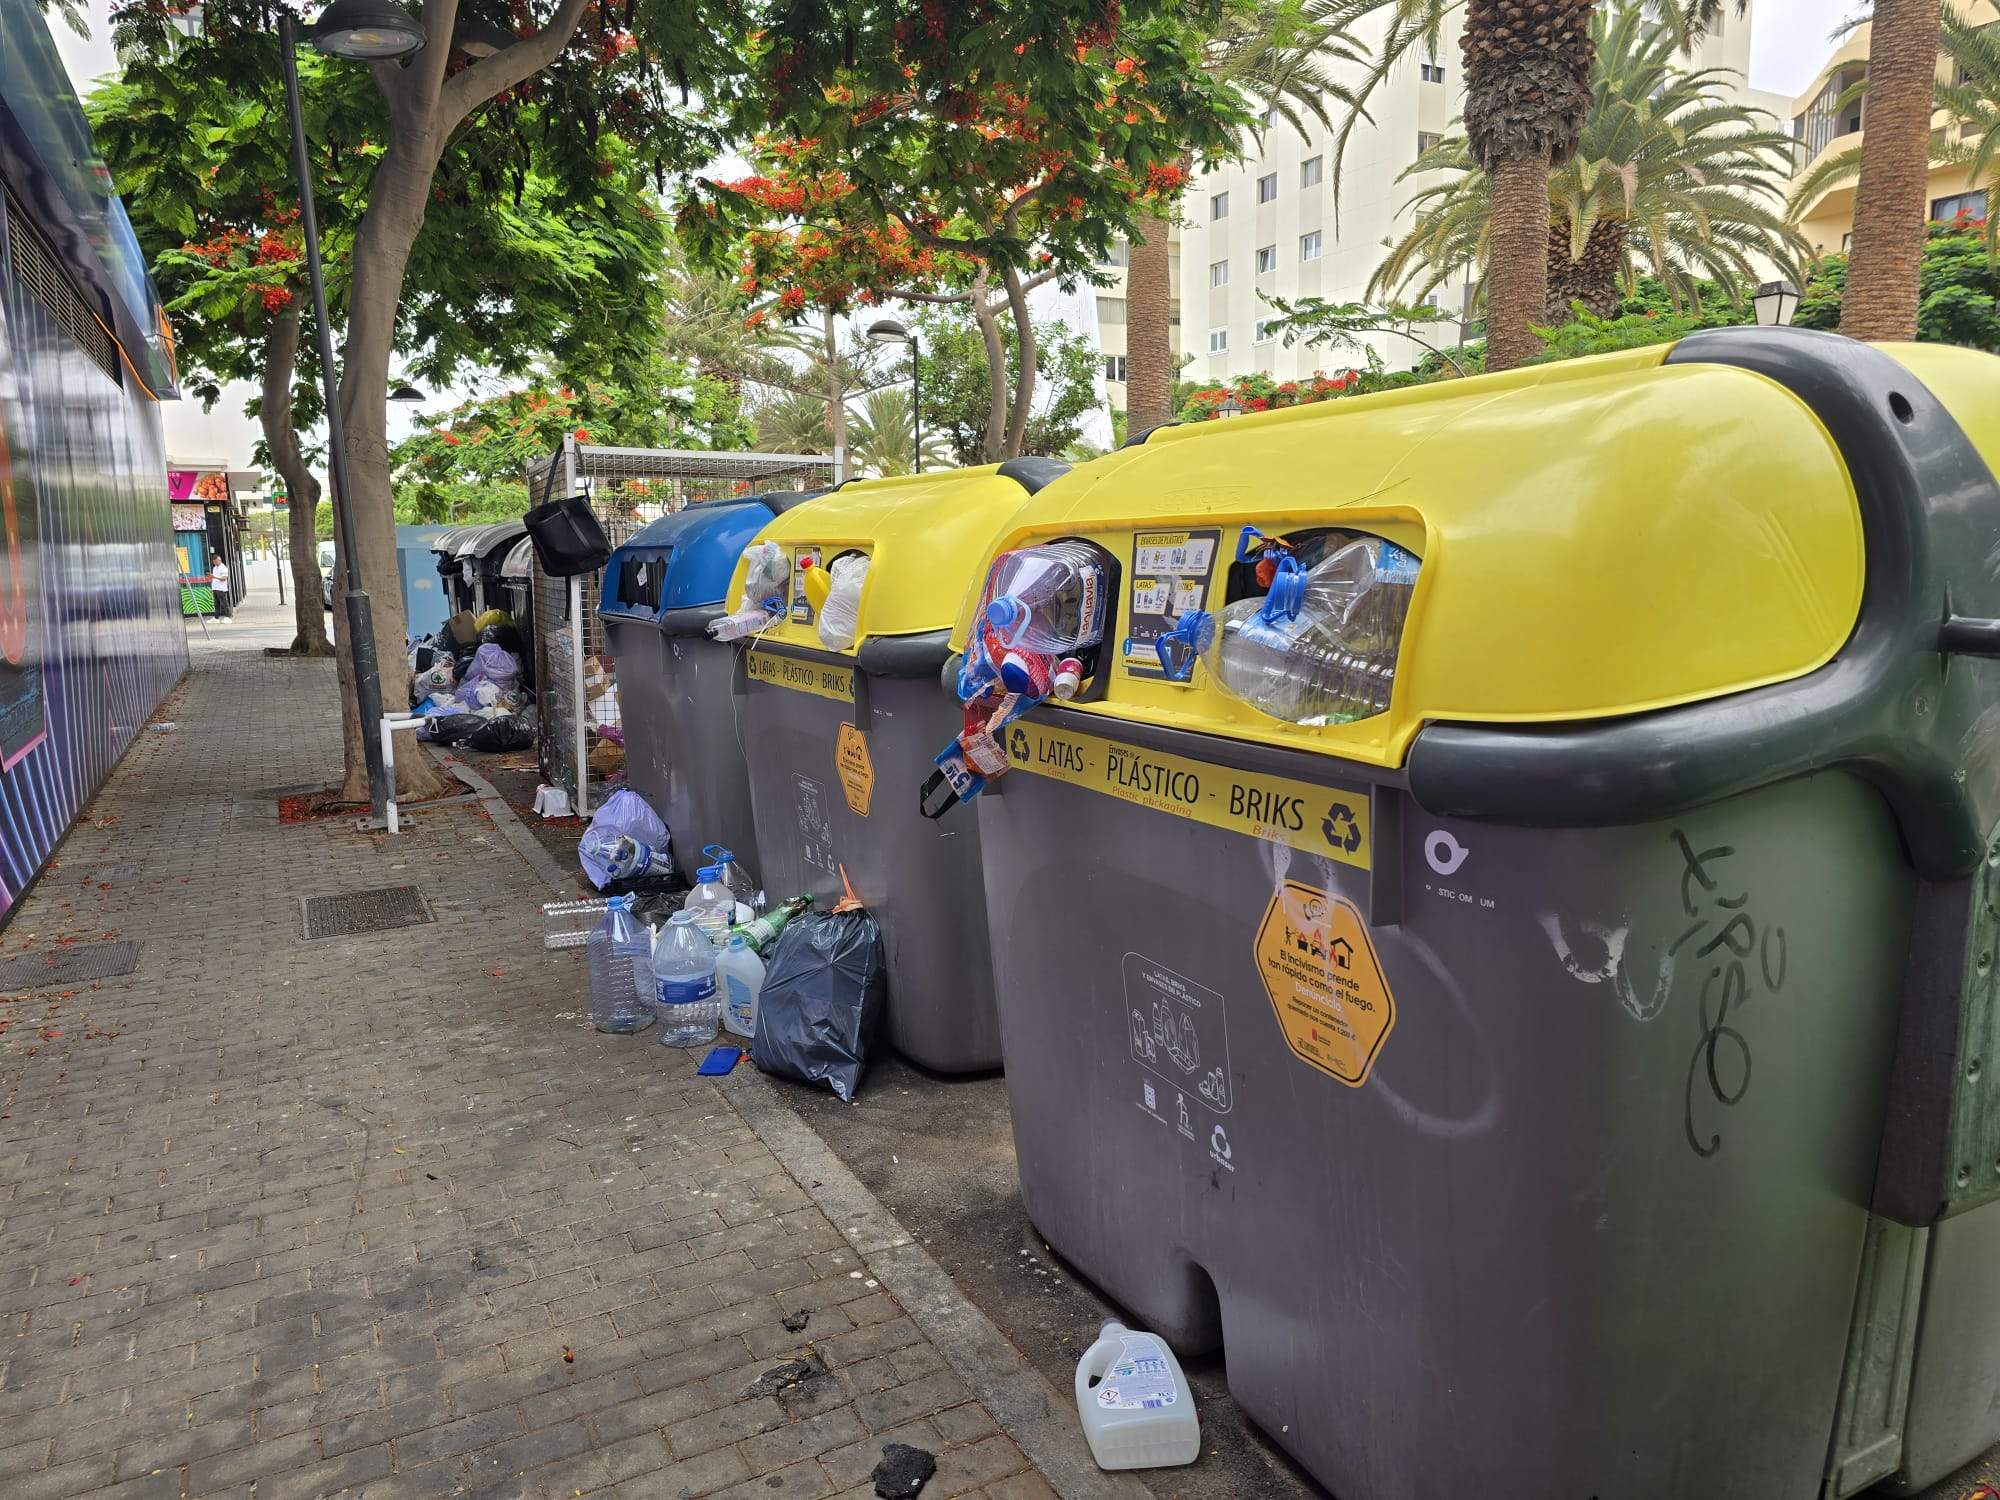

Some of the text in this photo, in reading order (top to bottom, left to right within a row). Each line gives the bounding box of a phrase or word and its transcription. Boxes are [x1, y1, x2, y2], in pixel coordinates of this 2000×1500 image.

[1136, 581, 1153, 589] LATAS
[760, 659, 776, 677] LATAS
[783, 664, 814, 686] PLÁSTICO
[822, 672, 845, 692] BRIKS
[1038, 737, 1084, 773] LATAS
[1106, 756, 1200, 804] PLÁSTICO
[1229, 784, 1305, 831] BRIKS
[1112, 785, 1193, 818] Plastic packaging
[1268, 956, 1376, 1013] tan rápido como el fuego.
[1280, 949, 1360, 992] El incivismo prende
